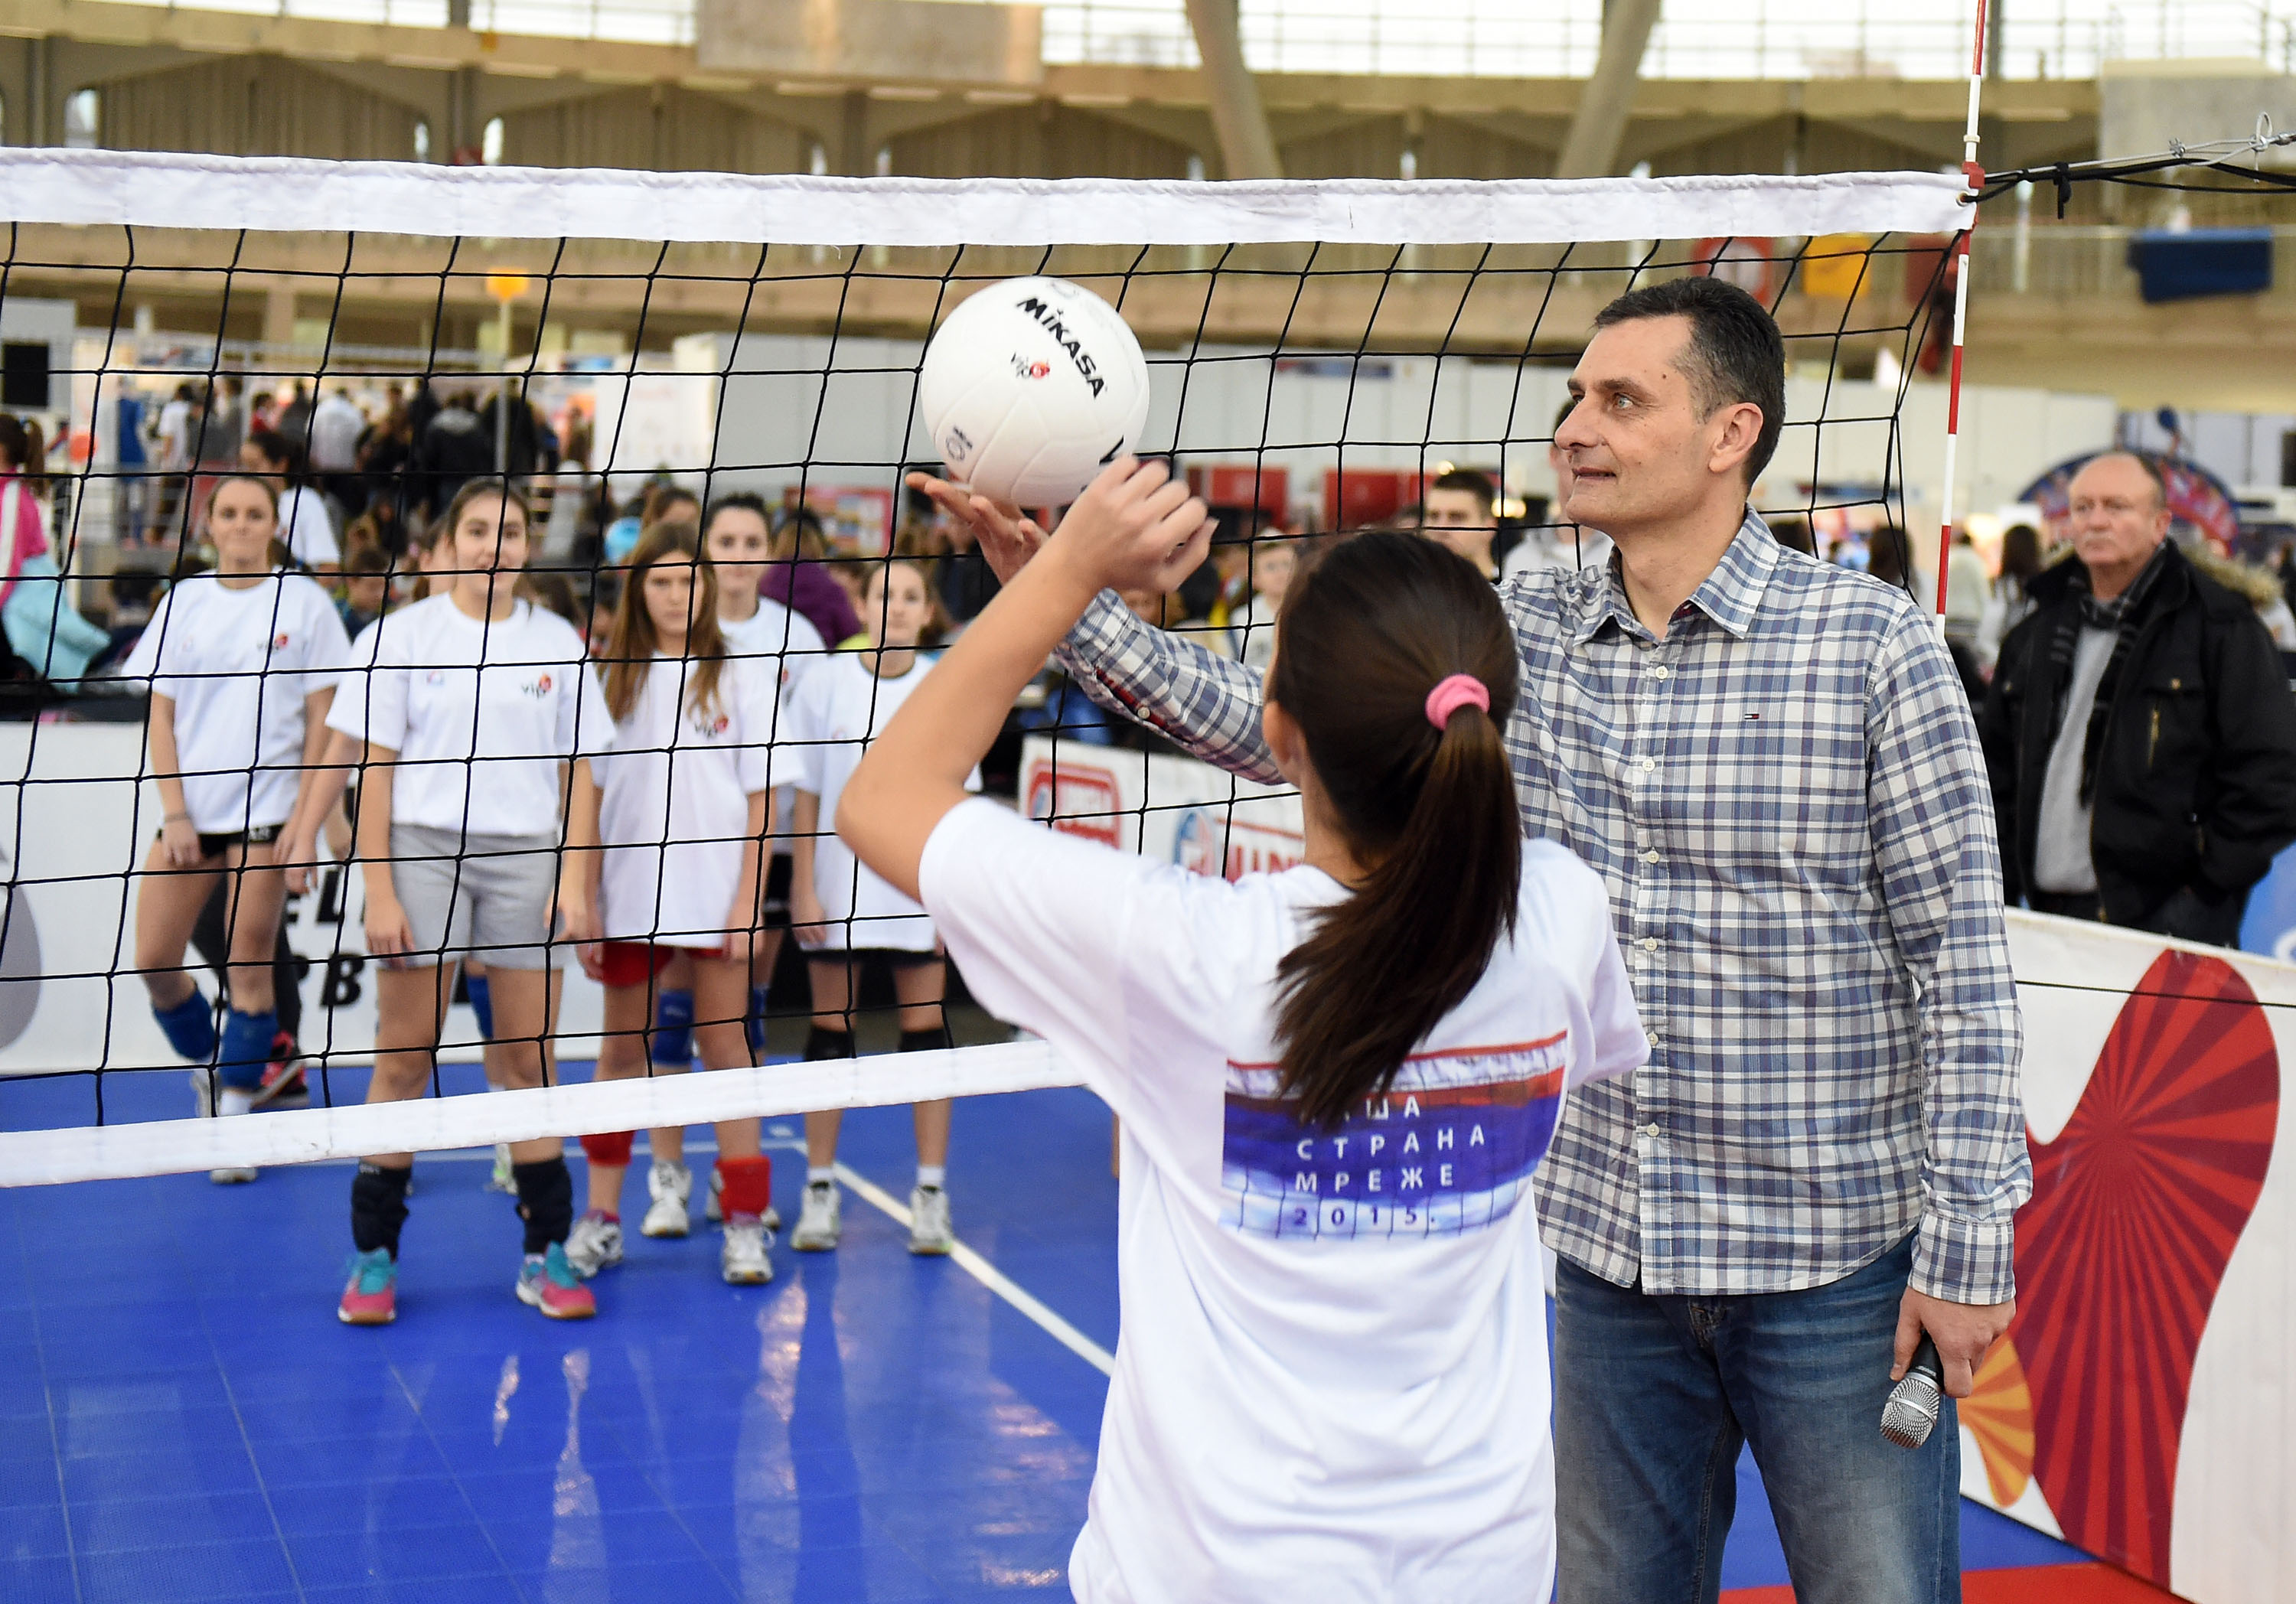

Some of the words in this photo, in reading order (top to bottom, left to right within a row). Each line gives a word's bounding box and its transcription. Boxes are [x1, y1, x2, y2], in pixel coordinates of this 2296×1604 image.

[1016, 297, 1105, 399] MIKASA
[1296, 1123, 1485, 1160] СТРАНА
[1294, 1163, 1453, 1193] МРЕЖЕ
[1293, 1206, 1437, 1226] 2015.
